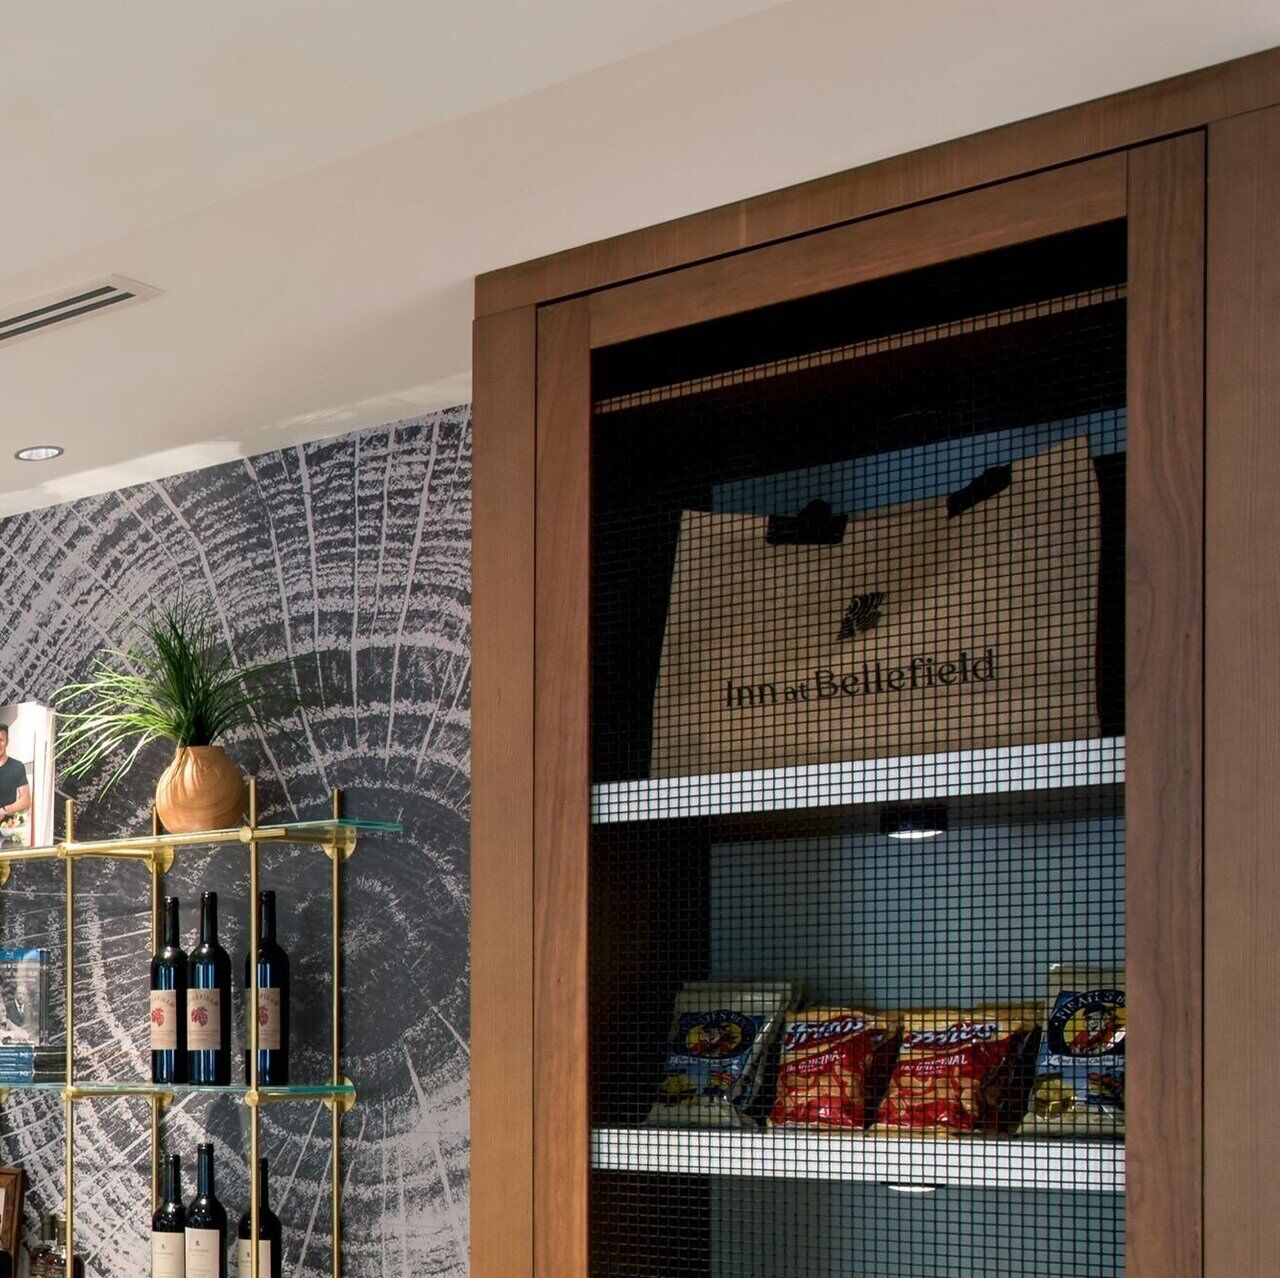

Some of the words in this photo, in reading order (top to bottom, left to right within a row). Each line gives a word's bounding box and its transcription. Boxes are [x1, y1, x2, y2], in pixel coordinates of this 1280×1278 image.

[726, 681, 778, 707] Inn
[784, 682, 808, 701] at
[815, 649, 996, 698] Bellefield
